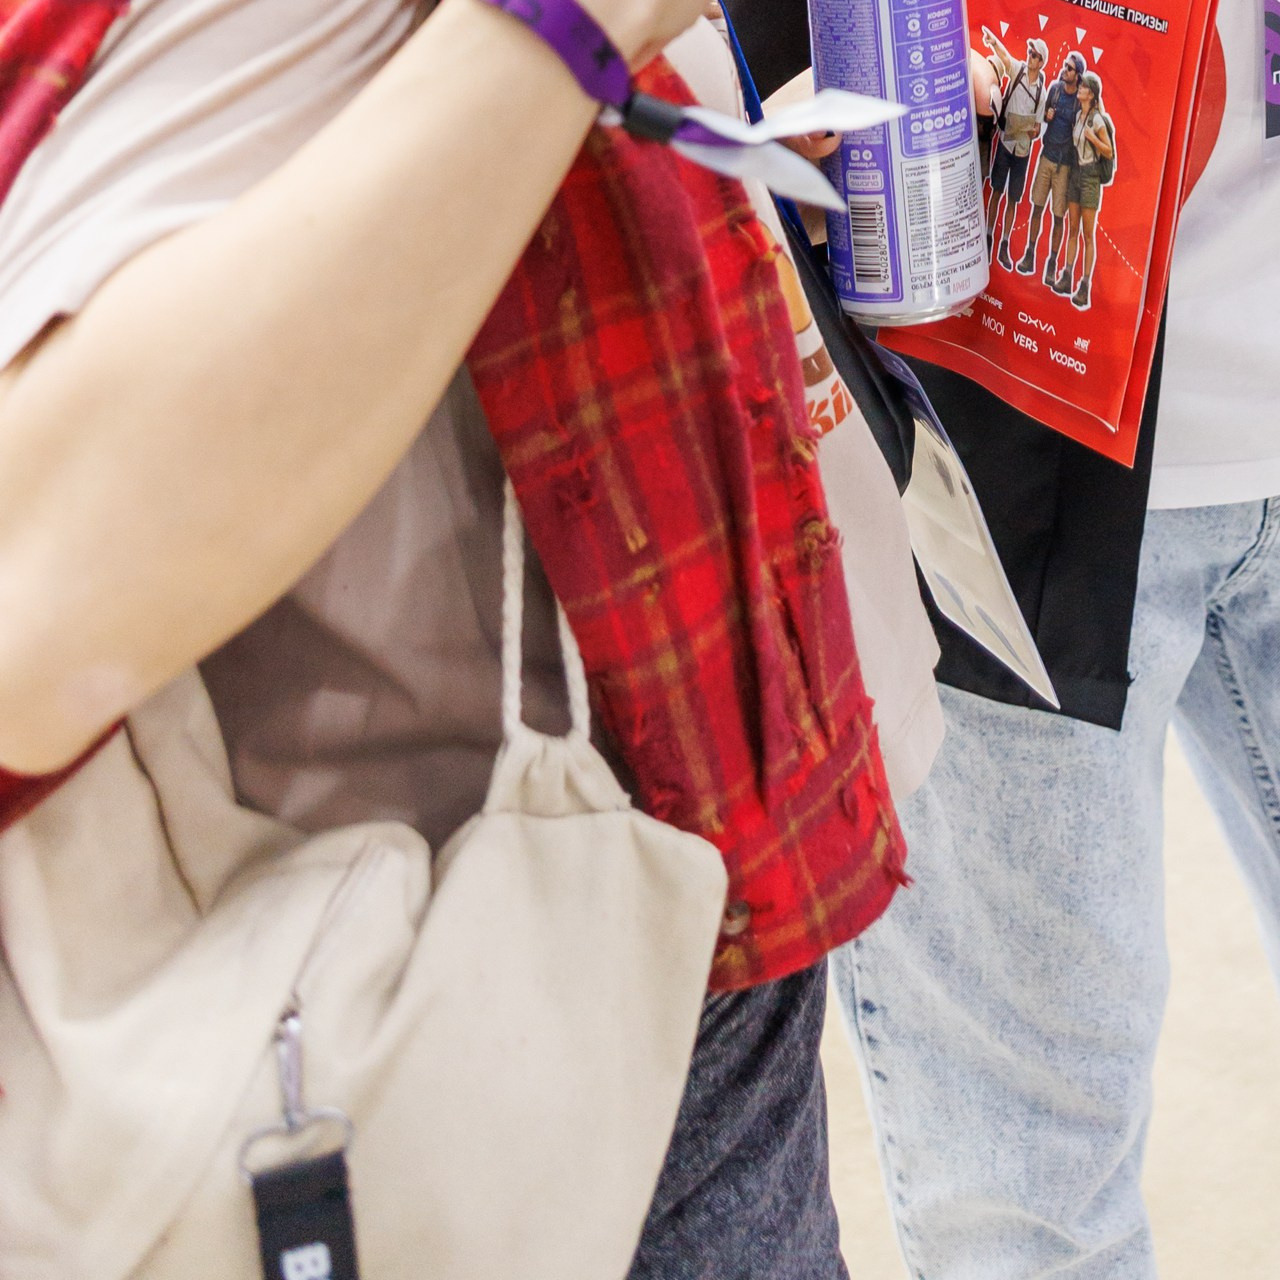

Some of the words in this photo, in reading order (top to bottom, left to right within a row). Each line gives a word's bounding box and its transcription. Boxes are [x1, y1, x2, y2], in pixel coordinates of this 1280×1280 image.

[1126, 9, 1169, 33] ПРИЗЫ!
[930, 39, 954, 52] ТАУРИН
[910, 104, 951, 121] ВИТАМИНЫ
[875, 204, 887, 240] 340449
[879, 244, 890, 280] 640280
[982, 313, 1005, 337] MOOI
[1012, 330, 1039, 353] VERS
[1049, 348, 1087, 375] VOOPOO
